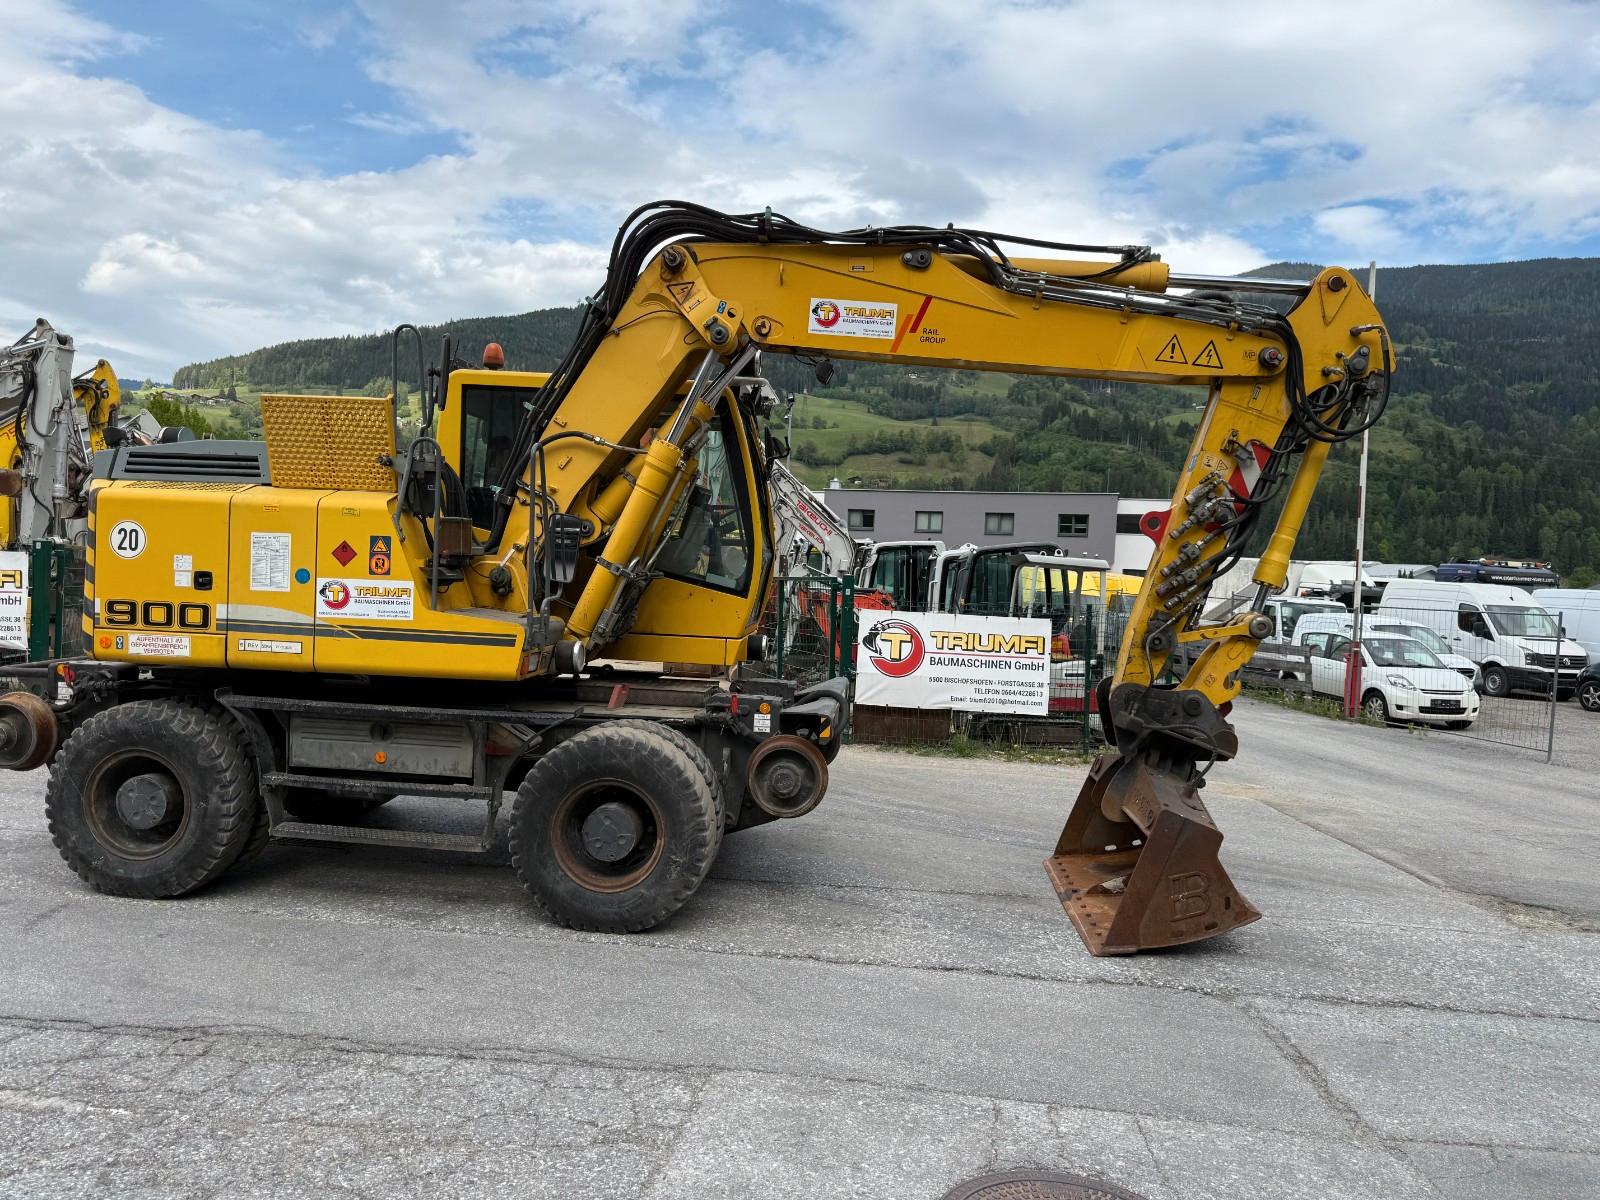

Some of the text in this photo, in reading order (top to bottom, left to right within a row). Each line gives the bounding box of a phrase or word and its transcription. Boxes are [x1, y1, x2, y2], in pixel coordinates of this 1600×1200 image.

[844, 307, 894, 319] TRIUMFI
[922, 328, 940, 336] RAIL
[920, 336, 946, 344] GROUP
[117, 527, 139, 551] 20
[354, 586, 411, 598] TRIUMFI
[105, 599, 212, 630] 900
[930, 630, 1046, 655] TRIUMFI
[929, 656, 1045, 672] BAUMASCHINEN GmbH
[944, 677, 993, 686] BISCHOFSHOFEN
[997, 680, 1036, 688] FORSTGASSE
[974, 687, 1000, 696] TELEFON
[950, 695, 968, 703] Email:
